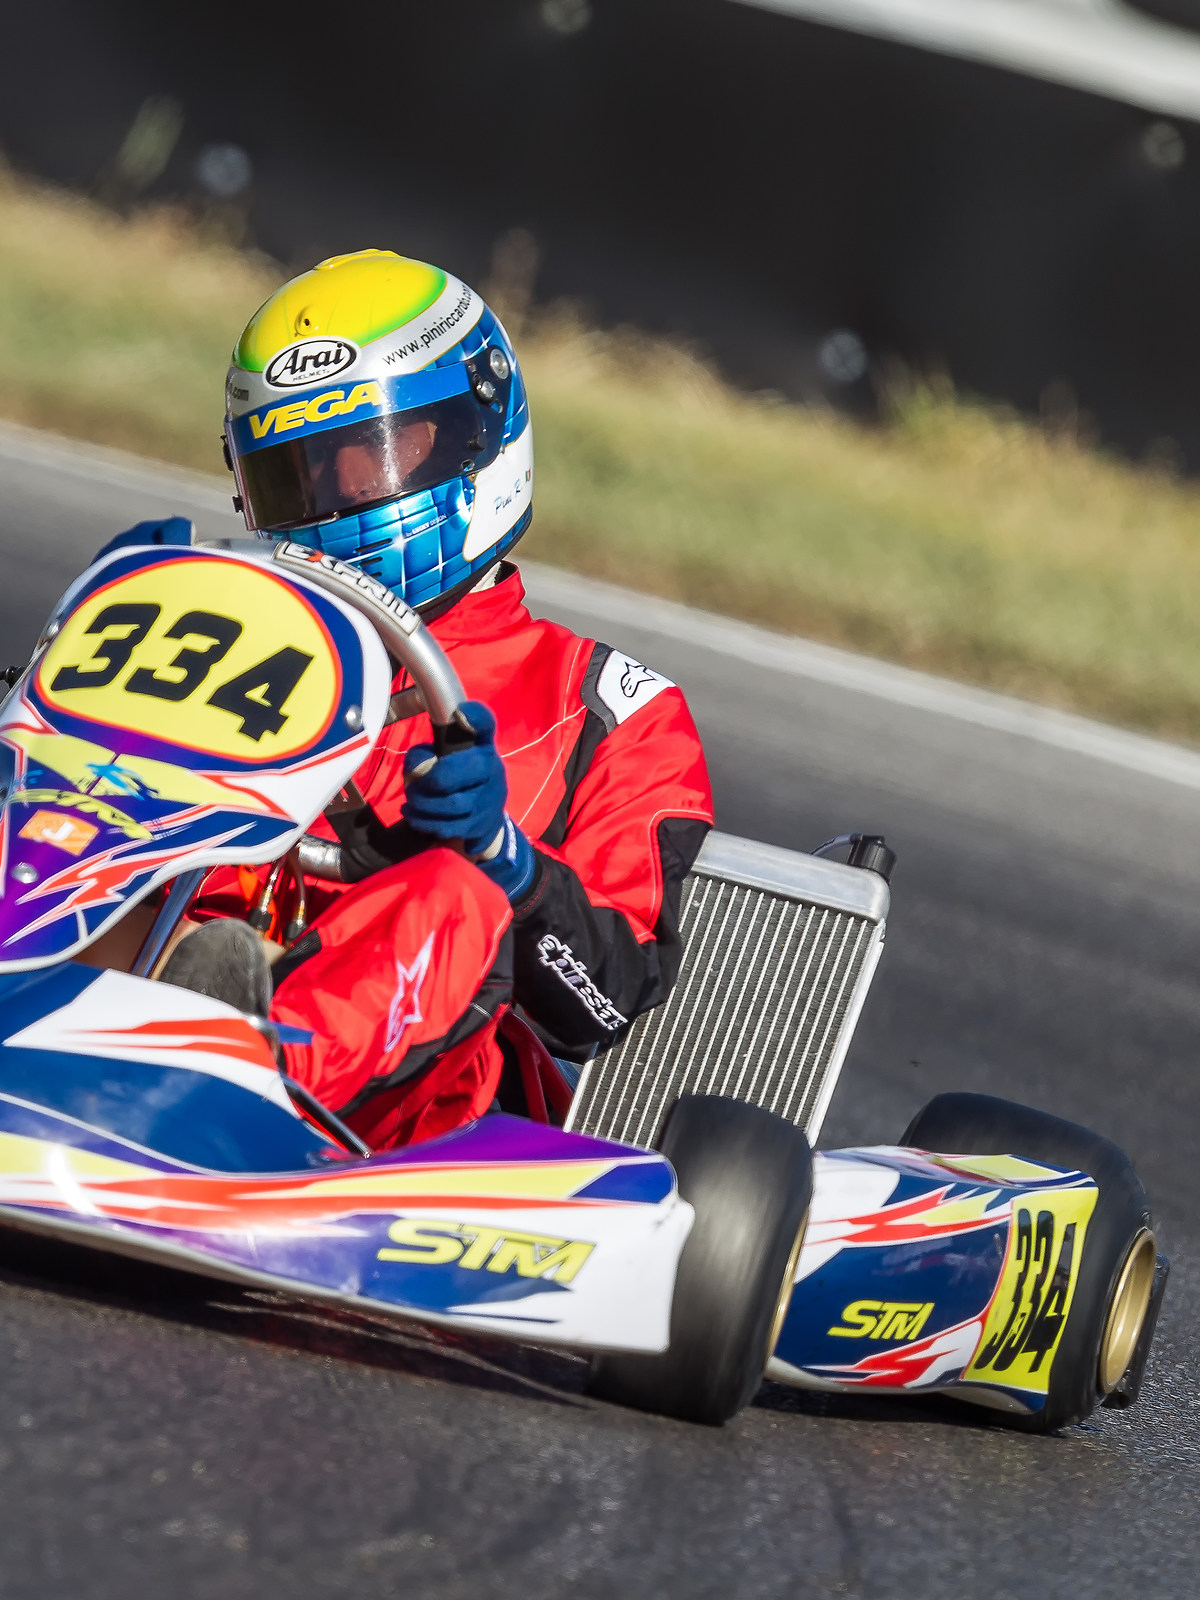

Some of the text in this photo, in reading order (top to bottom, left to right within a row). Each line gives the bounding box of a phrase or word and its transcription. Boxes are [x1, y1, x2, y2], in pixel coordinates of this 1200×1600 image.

[270, 341, 346, 381] Arai
[249, 381, 388, 439] VEGA
[51, 603, 315, 743] 334
[537, 934, 629, 1031] alpinestar
[376, 1218, 597, 1284] STM
[826, 1299, 936, 1340] STM
[973, 1208, 1078, 1374] 334
